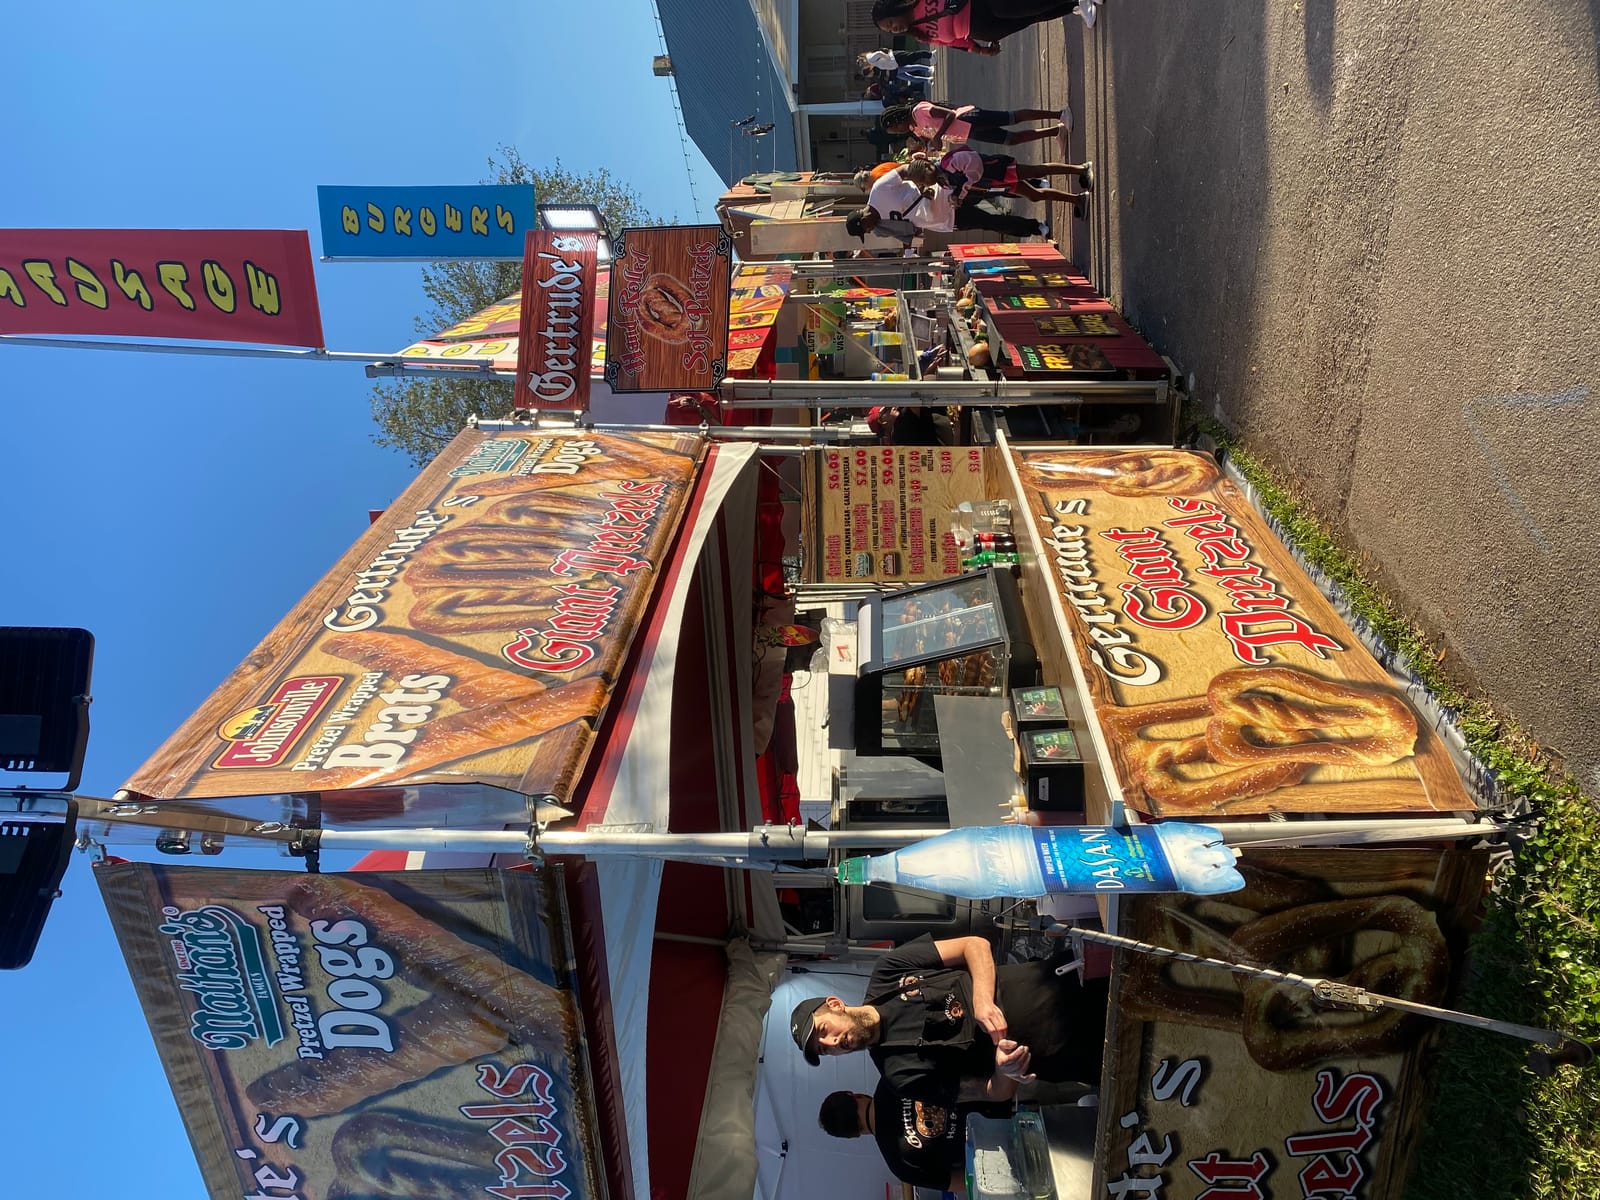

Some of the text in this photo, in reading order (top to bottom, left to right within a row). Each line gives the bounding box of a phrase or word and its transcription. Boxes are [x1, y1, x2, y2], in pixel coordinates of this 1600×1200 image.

[925, 0, 938, 38] GUSS
[341, 203, 515, 237] BURGERS
[0, 257, 281, 316] SAUSAGE
[612, 244, 651, 376] Hand Rolled
[681, 241, 717, 374] Soft Pretzels
[527, 236, 584, 400] Gertrude's
[1026, 353, 1042, 368] FRESH
[1036, 344, 1074, 369] FRIES
[448, 439, 516, 477] Nathan's
[512, 438, 554, 476] Pretzel Wrapped
[532, 440, 602, 474] Dogs
[828, 453, 840, 489] $6.00
[856, 450, 867, 486] $7.00
[882, 449, 893, 484] $9.00
[908, 450, 920, 473] $7.00
[941, 451, 952, 473] $3.00
[969, 450, 980, 472] $3.00
[910, 480, 921, 502] $4.00
[323, 496, 479, 632] Gertrude's
[501, 481, 666, 672] Giant Pretzels
[943, 554, 958, 574] Bottle
[1100, 527, 1208, 630] Giant
[1163, 495, 1344, 665] Pretzels
[1040, 499, 1162, 687] Gertrude's
[232, 682, 328, 762] Johnsonville
[291, 672, 383, 771] Pretzel Wrapped
[322, 674, 450, 770] Brats
[1078, 828, 1129, 888] DASANI
[159, 911, 259, 1049] Nathan's
[177, 953, 189, 968] SINCE
[258, 905, 323, 1059] Pretzel Wrapped
[251, 972, 269, 998] FAMOUS
[310, 919, 394, 1052] Dogs
[946, 1123, 957, 1139] Hot
[1286, 1070, 1384, 1200] els
[235, 1114, 299, 1200] e's
